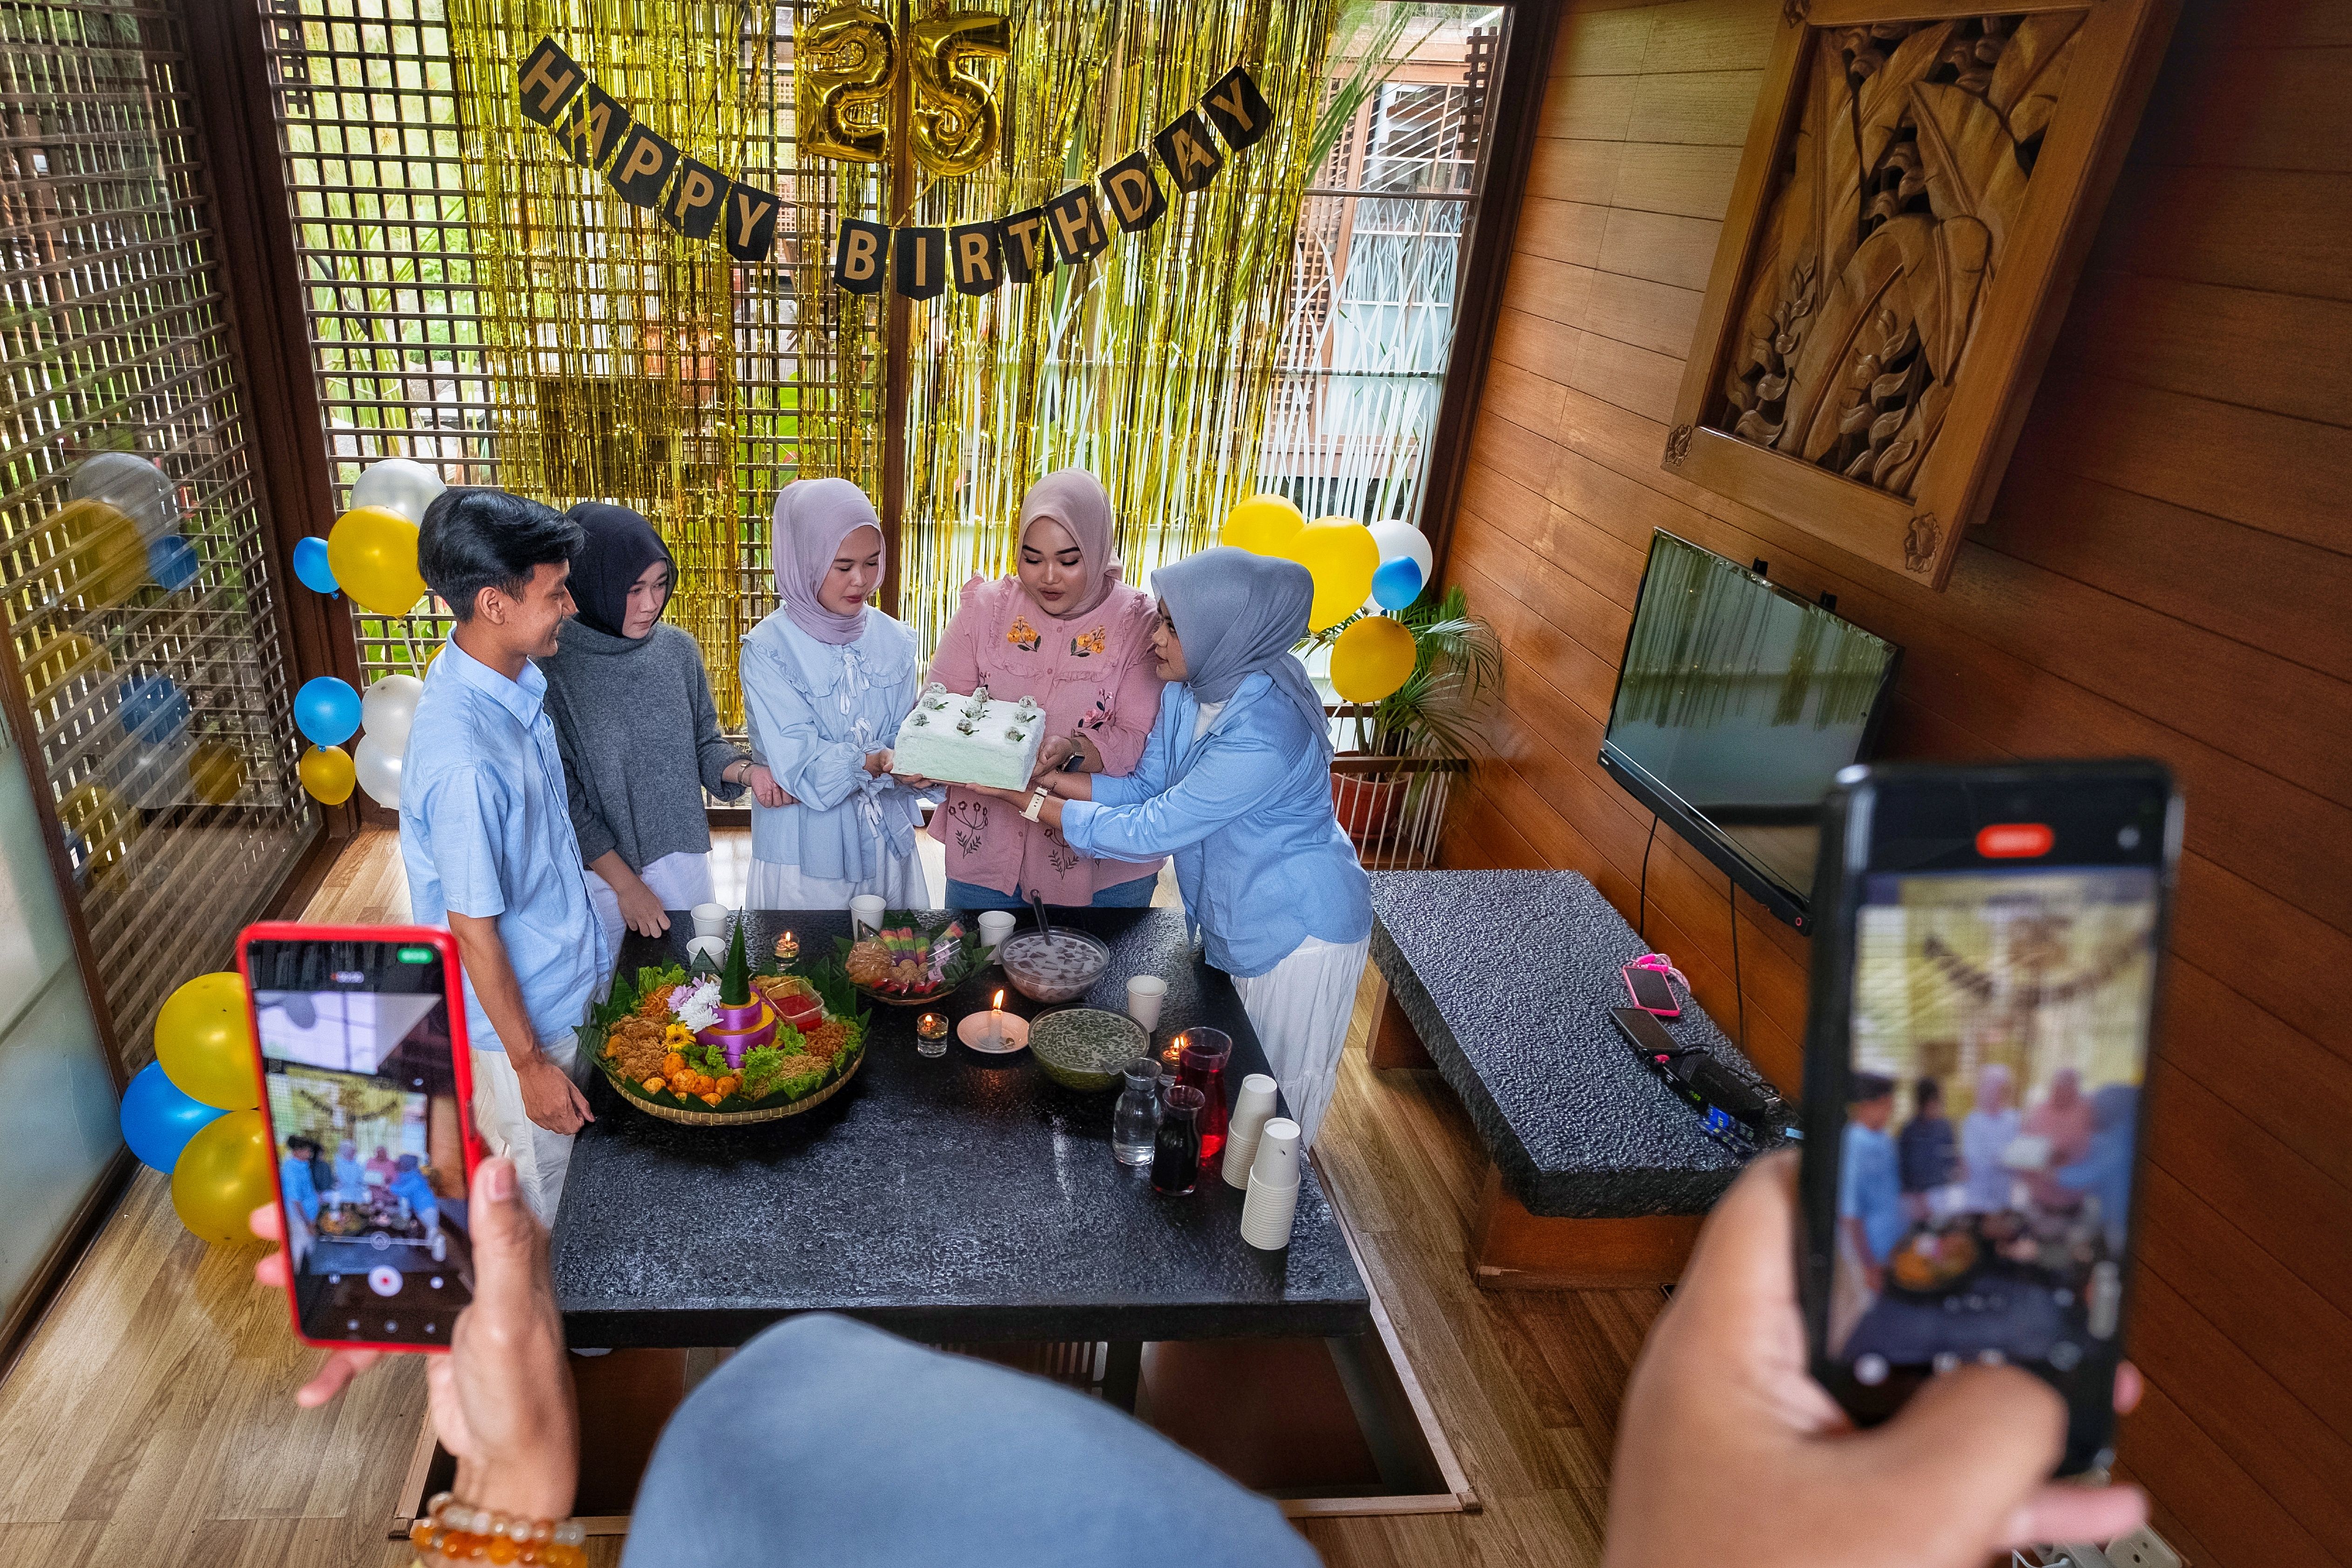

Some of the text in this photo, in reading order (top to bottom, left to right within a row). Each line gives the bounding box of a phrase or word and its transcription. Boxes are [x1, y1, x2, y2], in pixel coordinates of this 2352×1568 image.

[519, 49, 1253, 286] HAPPY BIRTHDAY
[802, 4, 1014, 177] 25
